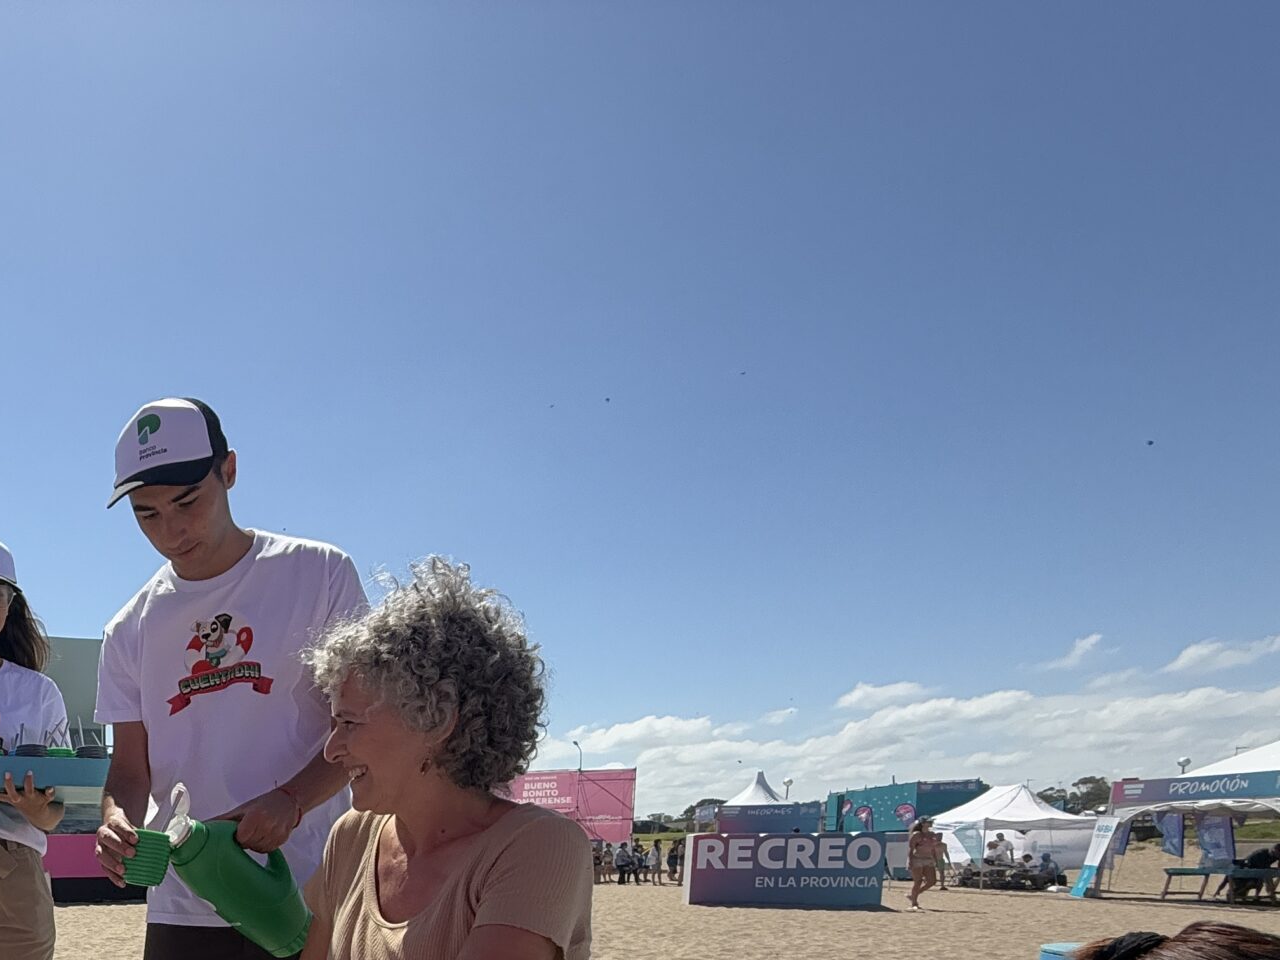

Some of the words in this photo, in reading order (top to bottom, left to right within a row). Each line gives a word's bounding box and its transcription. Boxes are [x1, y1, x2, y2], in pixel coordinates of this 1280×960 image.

[524, 781, 558, 790] BUENO
[1169, 775, 1249, 795] PROMOCIÓN
[522, 789, 559, 798] BONITO
[511, 796, 573, 805] ONAERENSE
[696, 837, 882, 870] RECREO
[755, 876, 775, 888] EN
[778, 876, 797, 888] LA
[800, 876, 879, 888] PROVINCIA
